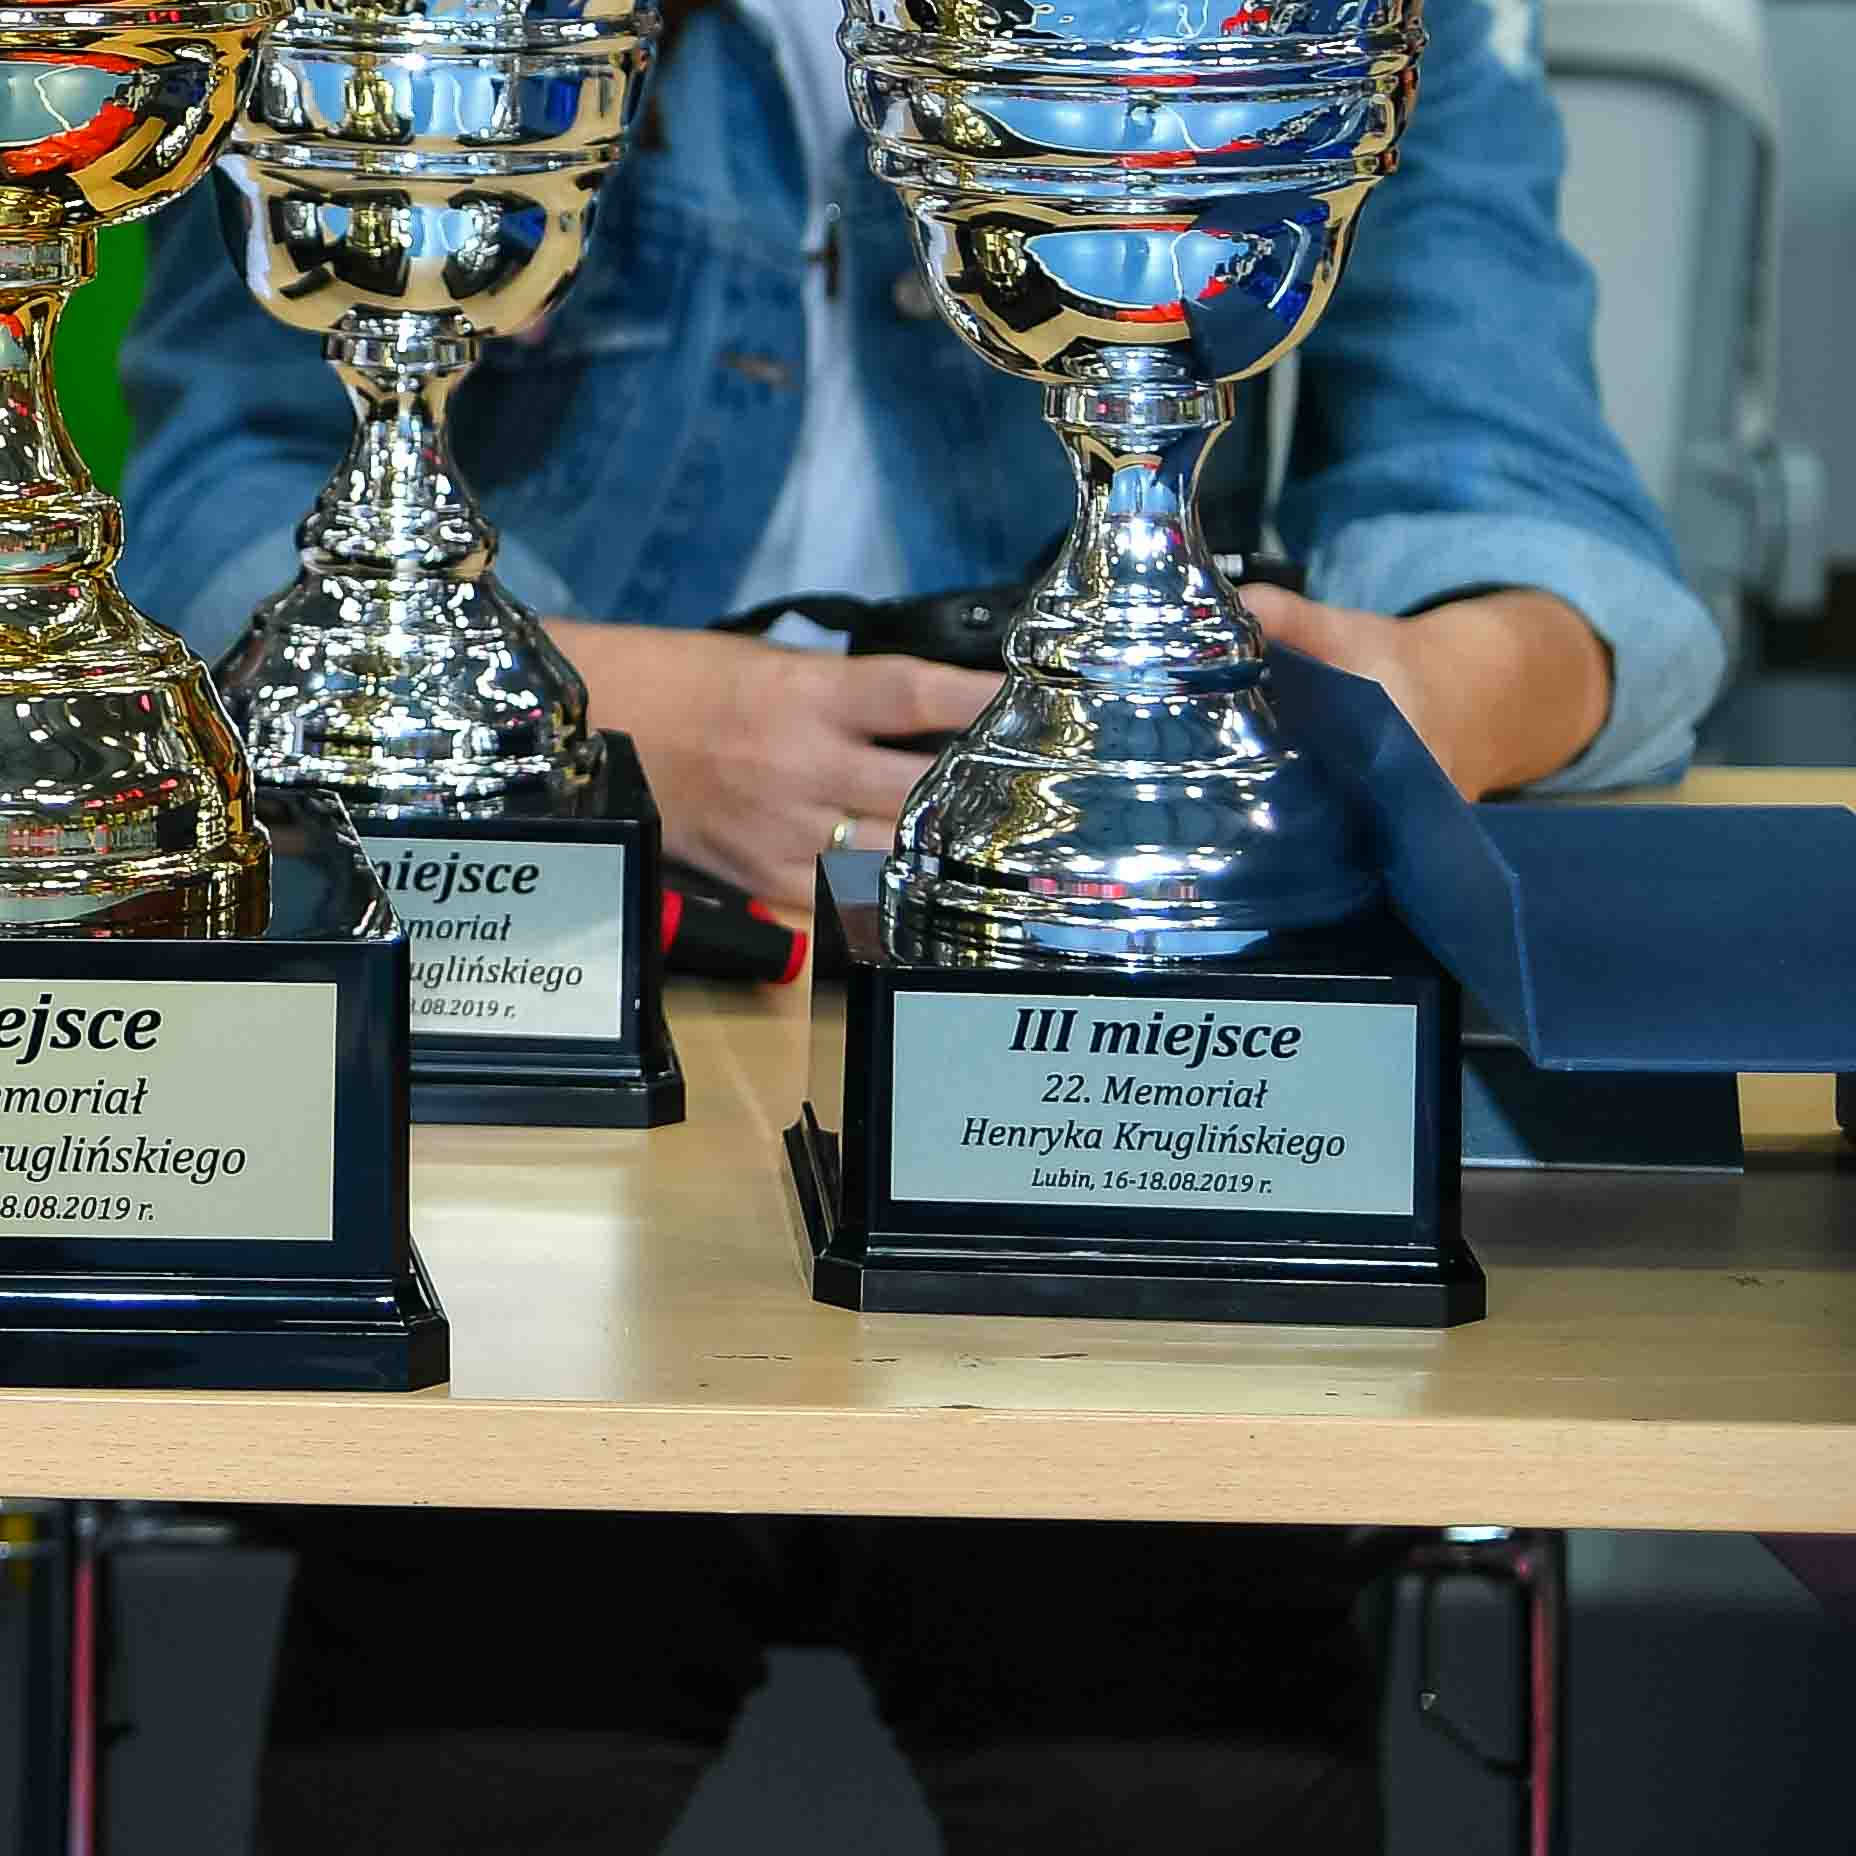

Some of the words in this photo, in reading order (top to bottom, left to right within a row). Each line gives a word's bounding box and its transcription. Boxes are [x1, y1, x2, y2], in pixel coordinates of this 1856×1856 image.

[400, 913, 513, 942] moriał
[410, 954, 584, 994] uglińskiego
[1008, 1008, 1079, 1053] III
[1089, 1011, 1303, 1069] miejsce
[1041, 1073, 1092, 1105] 22.
[1101, 1075, 1270, 1110] Memoriał
[960, 1117, 1104, 1156] Henryka
[1113, 1122, 1346, 1165] Kruglińskiego
[1031, 1167, 1096, 1192] Lubin,
[1103, 1170, 1255, 1194] 16-18.08.2019
[1259, 1179, 1273, 1195] r.
[138, 1203, 156, 1222] r.
